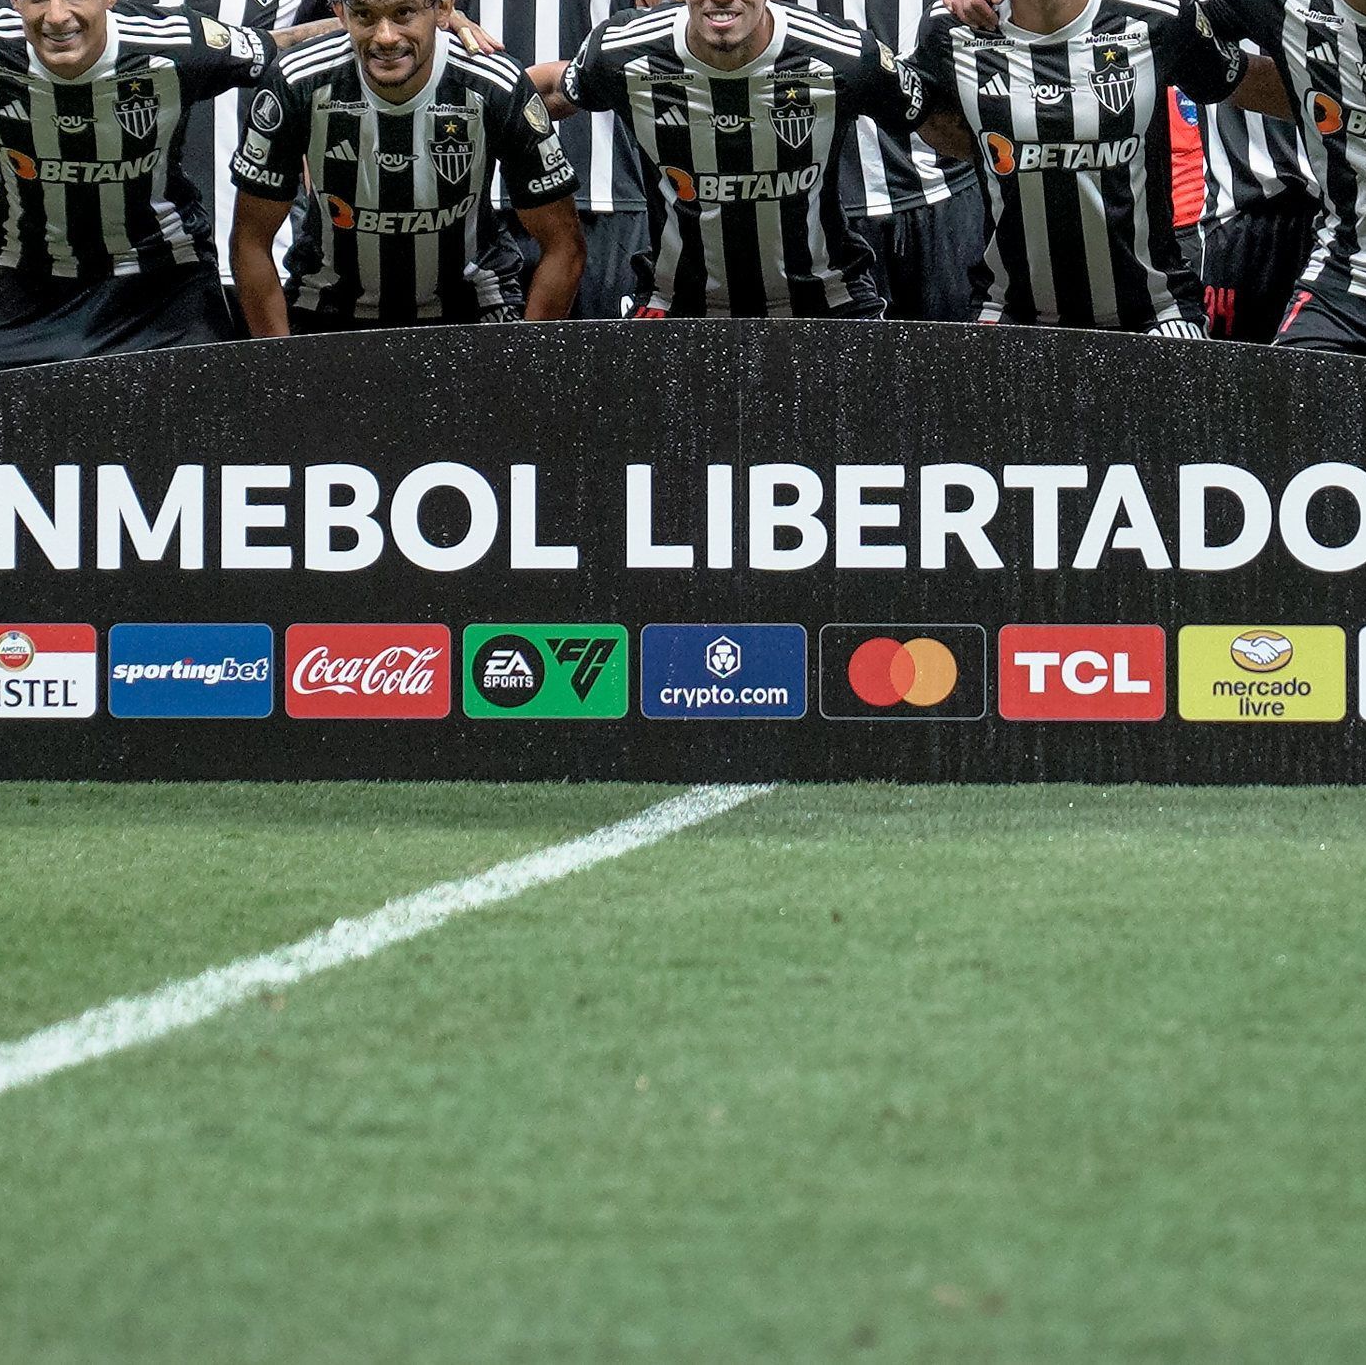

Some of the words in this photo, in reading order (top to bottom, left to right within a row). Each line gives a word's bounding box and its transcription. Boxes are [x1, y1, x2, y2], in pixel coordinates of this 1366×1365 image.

[1095, 70, 1131, 83] CAM
[120, 98, 155, 113] CAM
[775, 107, 812, 119] CAM
[435, 144, 469, 154] CAM
[1019, 136, 1138, 170] BETANO
[40, 147, 161, 184] BETANO
[233, 151, 285, 187] ERDAU
[698, 164, 821, 202] BETANO
[357, 193, 475, 234] BETANO
[112, 657, 270, 685] sportingbet
[292, 646, 443, 696] Coca-Cola
[485, 649, 533, 675] EA
[1013, 650, 1151, 695] TCL
[483, 675, 534, 688] SPORTS
[1212, 677, 1312, 696] mercado
[658, 683, 789, 709] crypto.com
[1239, 697, 1286, 716] livre
